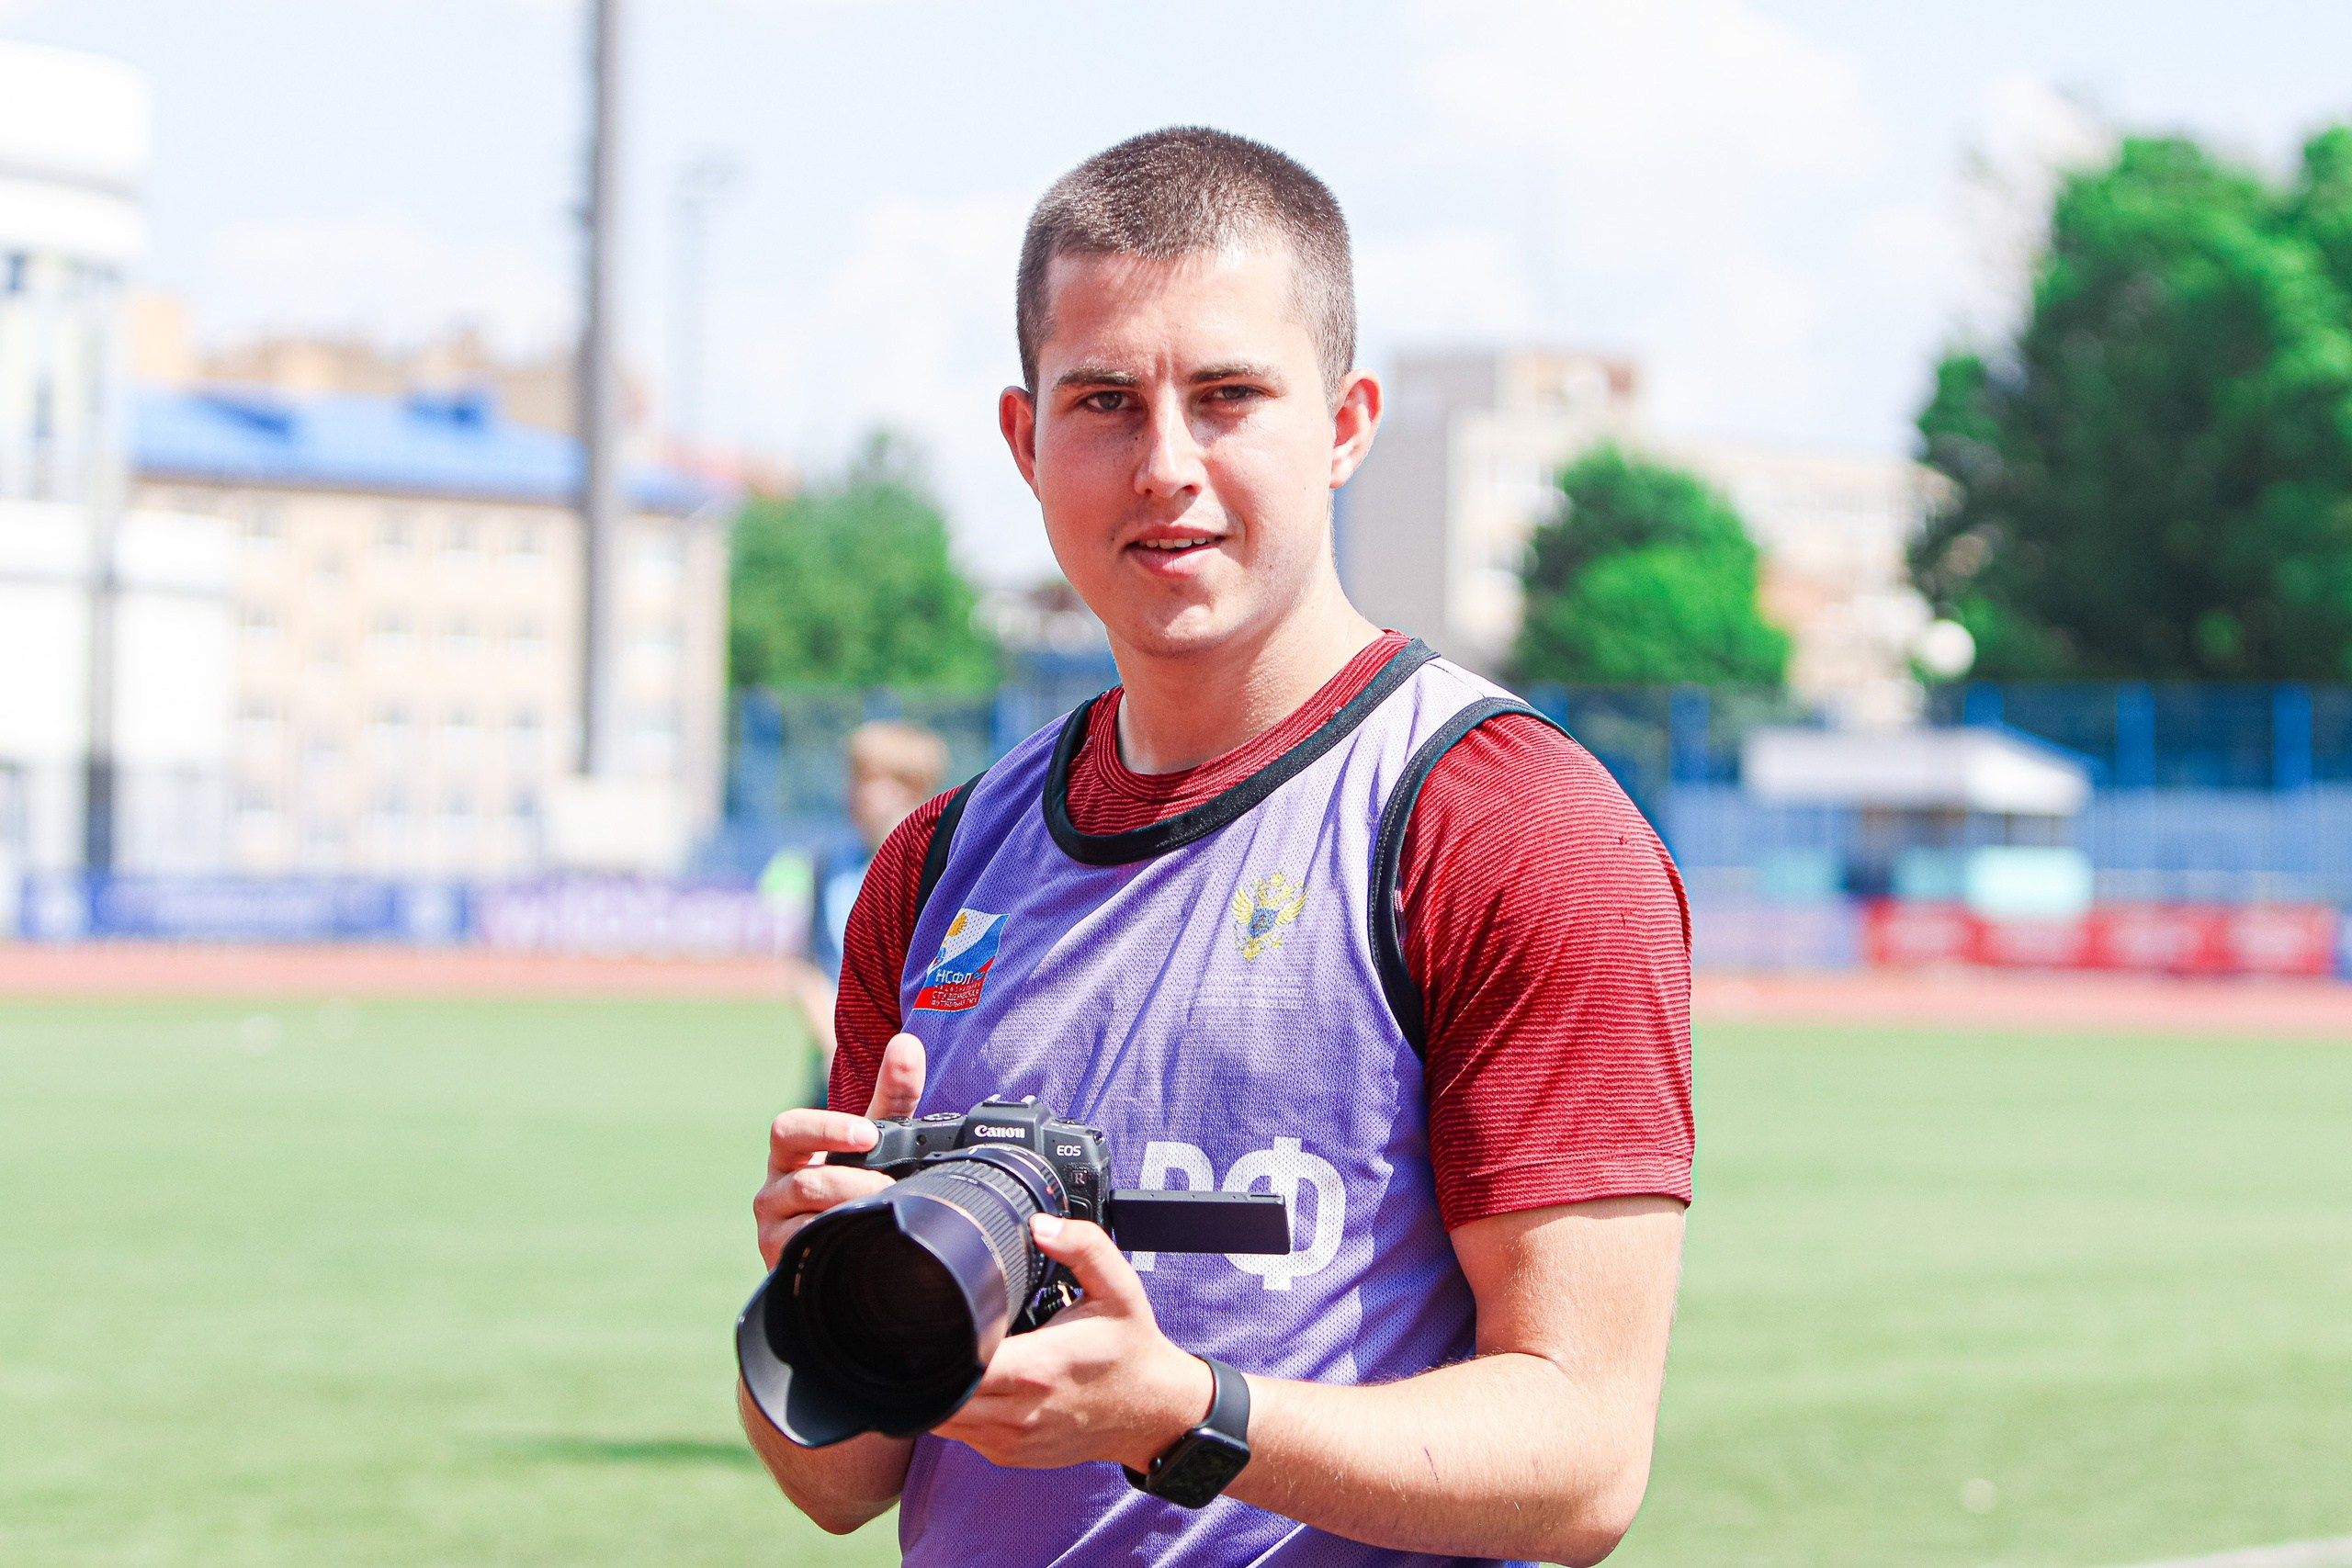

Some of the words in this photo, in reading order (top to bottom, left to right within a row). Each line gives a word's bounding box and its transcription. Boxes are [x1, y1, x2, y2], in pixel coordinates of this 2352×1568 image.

[935, 969, 974, 985] НСФЛ
[975, 1124, 1025, 1138] Canon
[1057, 1145, 1081, 1156] EOS
[1073, 1173, 1085, 1185] R
